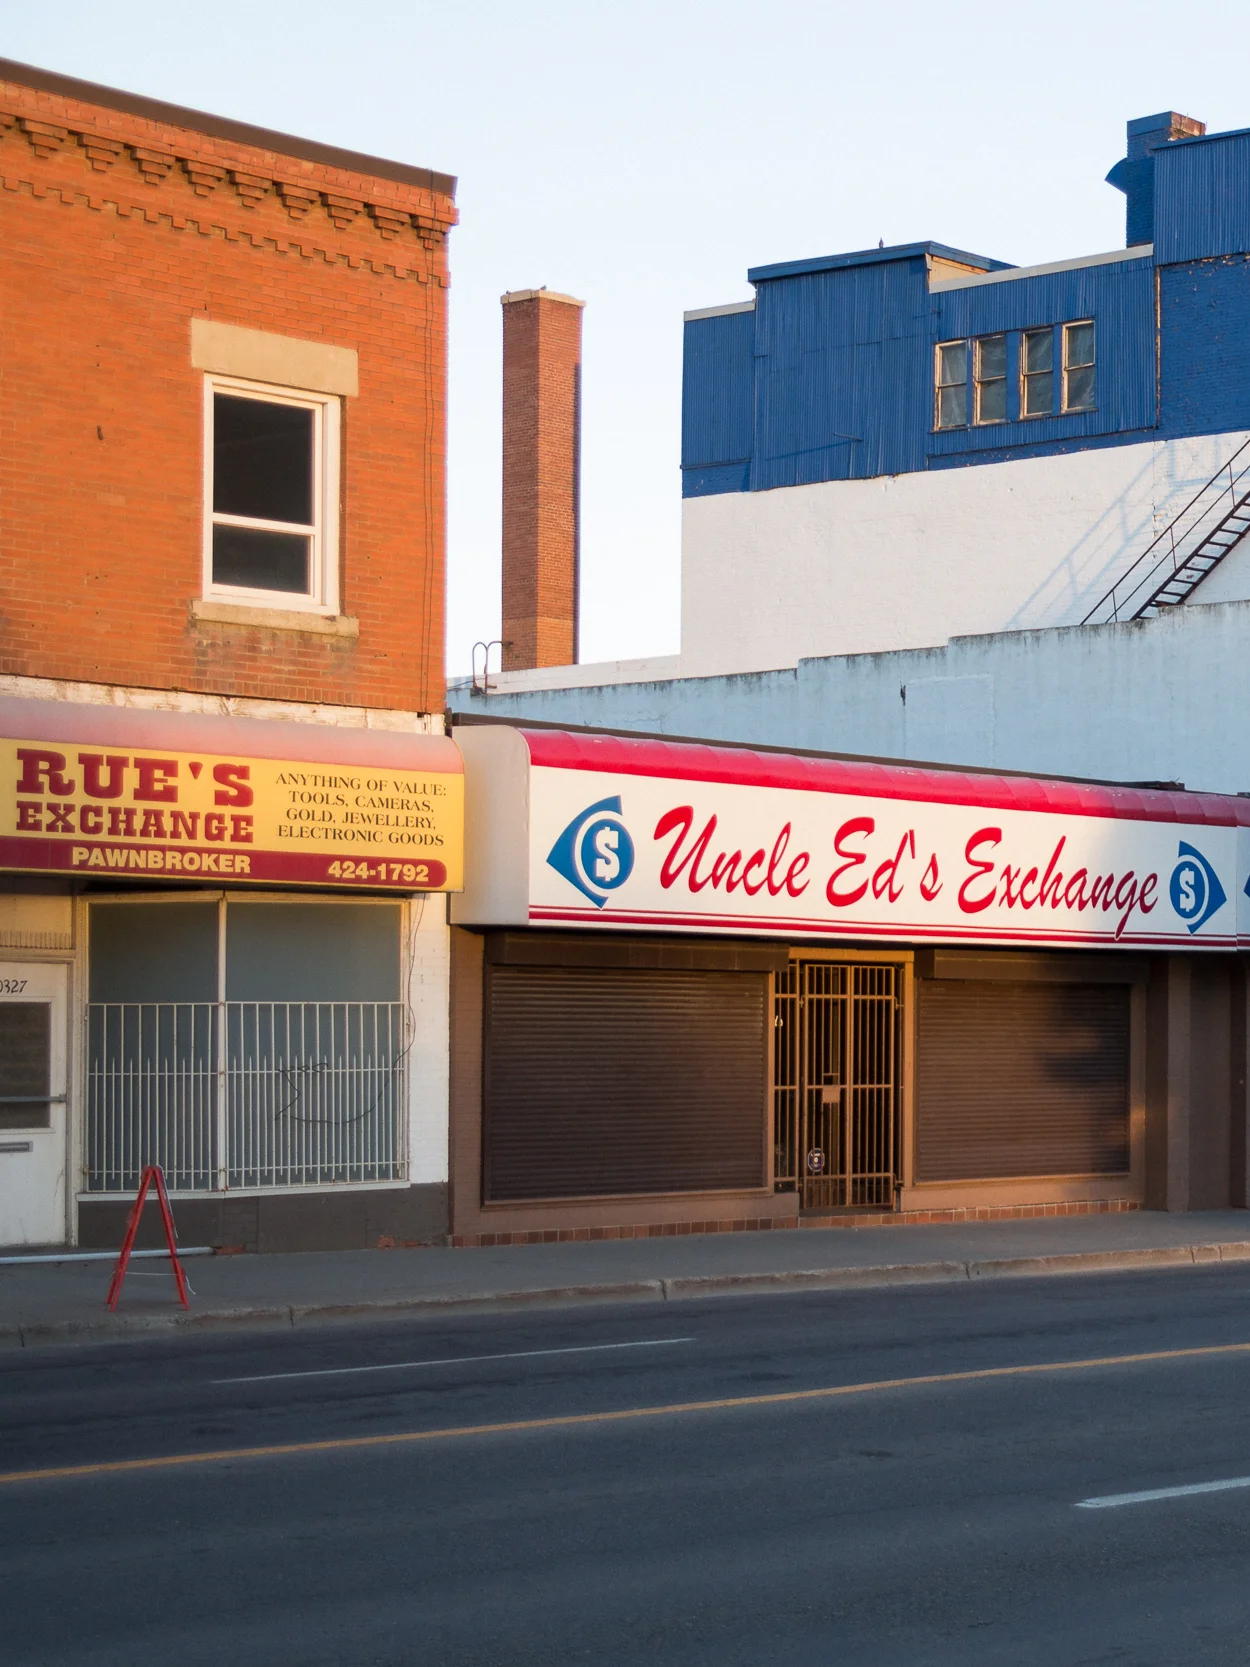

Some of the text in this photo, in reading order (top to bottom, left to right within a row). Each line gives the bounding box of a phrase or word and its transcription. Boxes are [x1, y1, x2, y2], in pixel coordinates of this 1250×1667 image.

[16, 748, 254, 807] RUE'S
[275, 772, 446, 796] ANYTHING OF VALUE:
[289, 790, 434, 813] TOOLS, CAMERAS,
[16, 801, 254, 844] EXCHANGE
[286, 807, 436, 830] GOLD, JEWELLERY,
[277, 824, 444, 847] ELECTRONIC GOODS
[72, 846, 251, 873] PAWNBROKER
[328, 860, 429, 882] 424-1792
[653, 805, 1158, 941] Uncle Ed's Exchange
